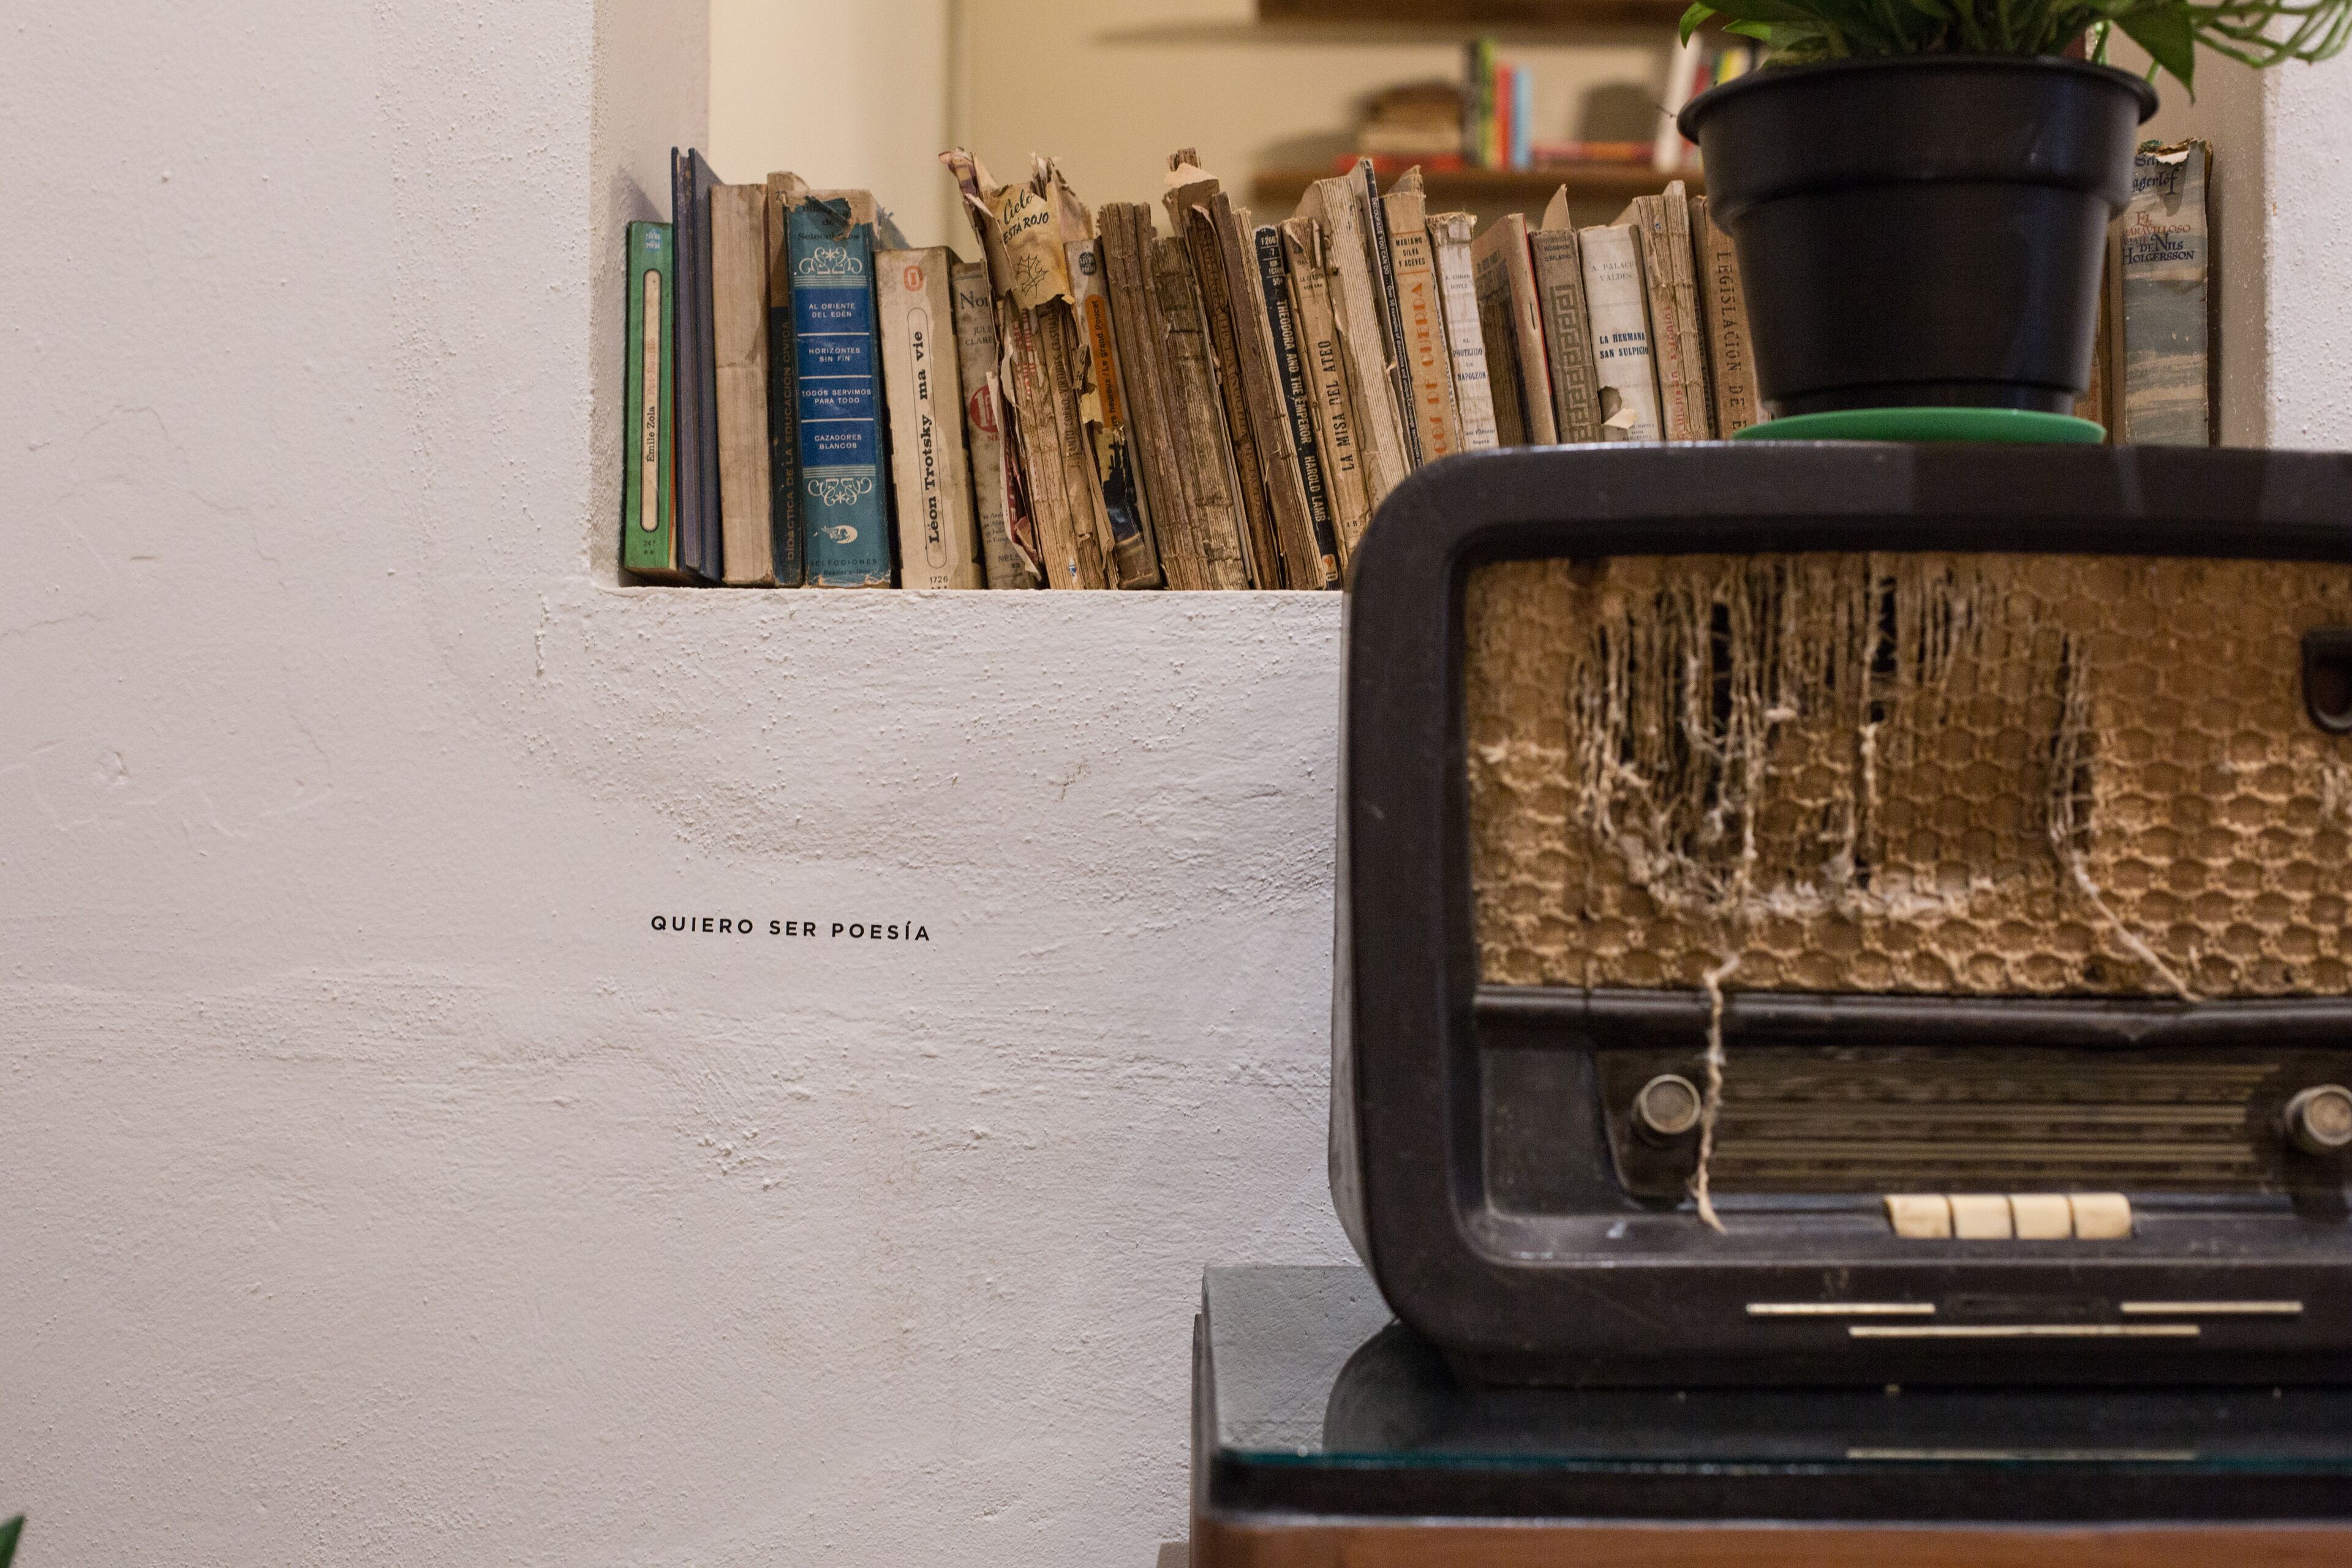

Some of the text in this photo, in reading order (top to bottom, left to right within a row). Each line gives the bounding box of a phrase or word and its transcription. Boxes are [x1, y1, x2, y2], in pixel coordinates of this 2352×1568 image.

[2133, 168, 2178, 195] agerlöf
[1004, 189, 1035, 225] Cielo
[1371, 197, 1382, 235] DECOUPAGE
[1023, 213, 1049, 228] ROJO
[1396, 238, 1422, 246] MARIANO
[1405, 257, 1425, 266] ACEVES
[2122, 247, 2195, 265] HOLGERSSON
[1600, 332, 1645, 344] LA HERMANA
[1453, 347, 1483, 358] PROTEJIDO
[1600, 345, 1649, 360] SAN SULPICIO
[1458, 372, 1487, 381] NAPOLEON
[1317, 341, 1355, 471] LA MISA DEL ATEO
[1729, 385, 1744, 407] DE
[647, 405, 656, 429] Zola
[1277, 300, 1326, 522] THEODORA AND THE EMPEROR HAROLD LAMB
[646, 431, 655, 462] Émile
[913, 331, 940, 544] Léon Trotsky ma vie
[650, 915, 930, 941] QUIERO SER POESÍA
